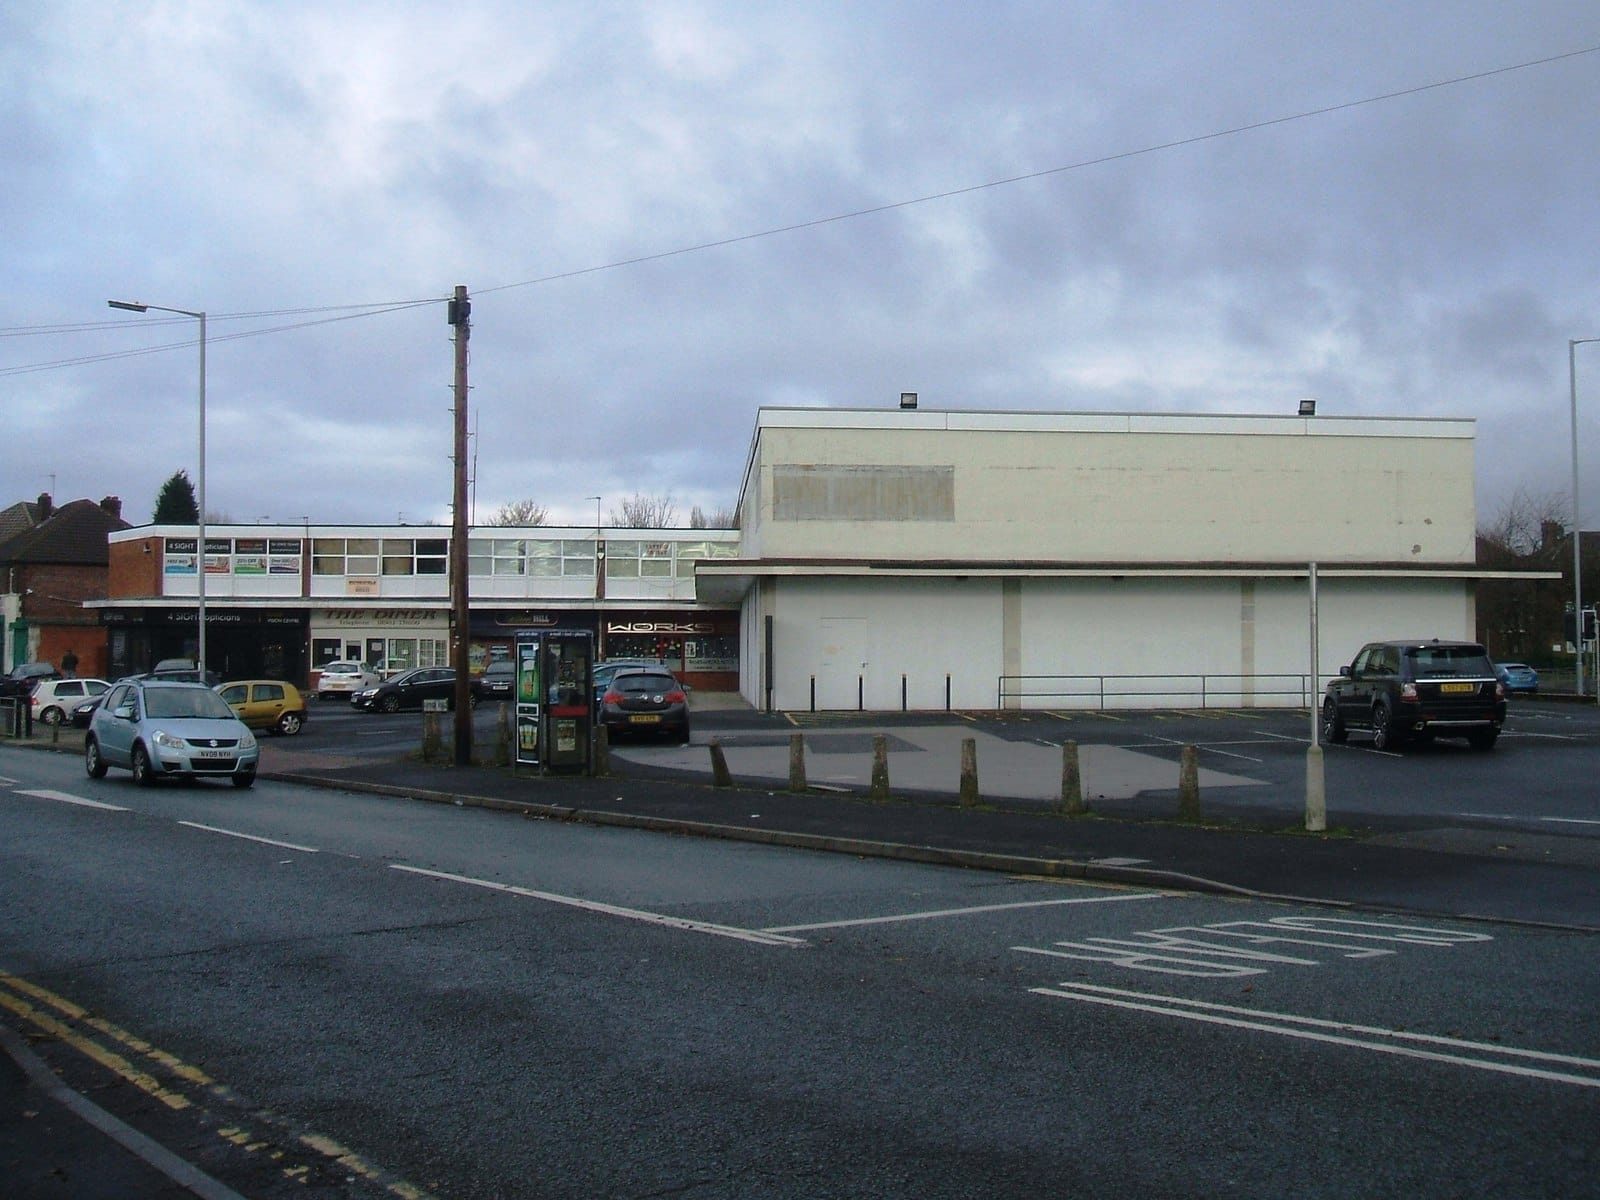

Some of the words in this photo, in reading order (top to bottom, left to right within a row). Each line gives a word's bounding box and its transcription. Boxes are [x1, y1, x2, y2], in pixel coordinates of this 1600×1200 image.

[174, 542, 194, 551] SIGHT
[204, 543, 230, 552] pticians
[167, 612, 174, 620] 4
[175, 612, 202, 621] SIGH
[327, 610, 366, 620] THE
[374, 610, 437, 620] DINER
[607, 621, 714, 633] WORKS
[1009, 916, 1494, 978] CLEAR
